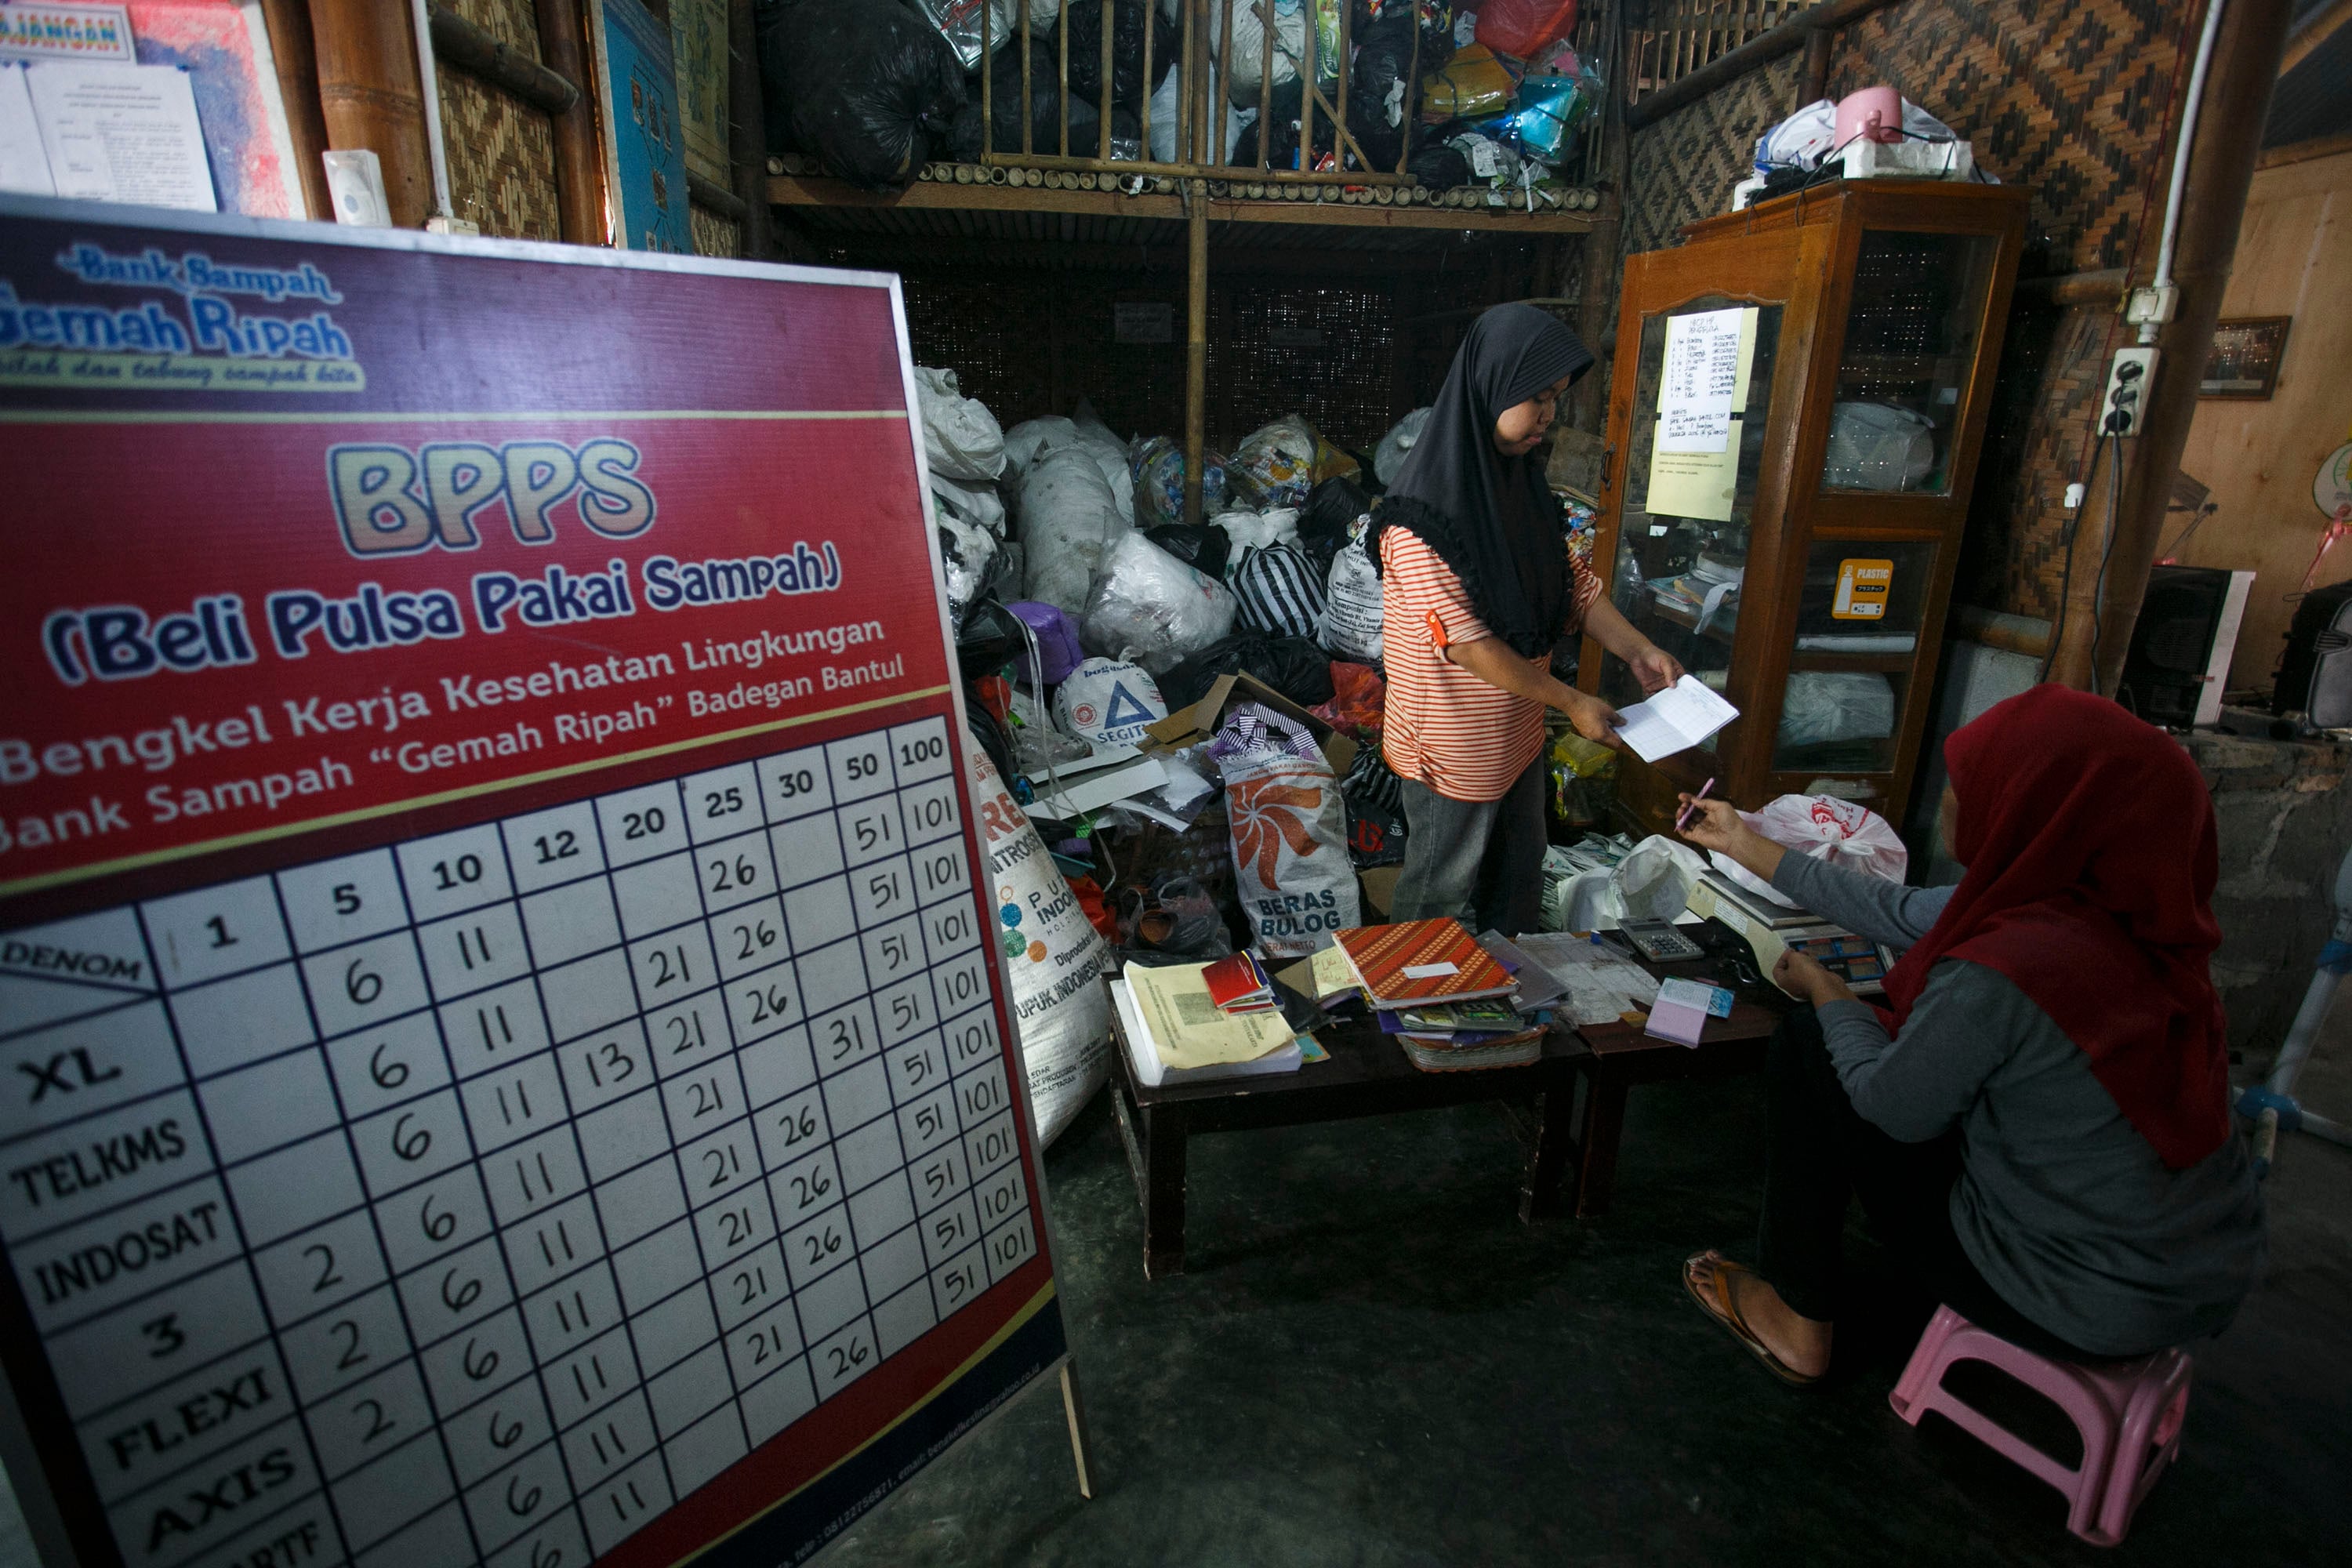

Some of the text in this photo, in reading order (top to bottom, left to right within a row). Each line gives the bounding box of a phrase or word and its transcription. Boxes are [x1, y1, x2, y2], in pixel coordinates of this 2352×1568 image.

[181, 251, 343, 304] Sampah
[188, 292, 354, 361] Ripah
[326, 439, 656, 560] BPPS
[1857, 568, 1889, 579] PLASTIC
[0, 617, 885, 784] Bengkel Kerja Kesehatan Lingkungan
[42, 593, 257, 686] (Beli
[267, 582, 465, 659] Pulsa
[474, 557, 635, 633] Pakai
[146, 756, 354, 822] Sampah
[688, 671, 813, 719] Badegan
[822, 652, 906, 692] Bantul
[2, 942, 142, 981] DENOM
[205, 915, 239, 949] 1
[332, 883, 362, 916] 5
[432, 854, 483, 891] 10
[534, 829, 580, 865] 12
[622, 808, 666, 840] 20
[705, 787, 743, 818] 25
[779, 770, 814, 798] 30
[847, 753, 878, 781] 50
[901, 737, 942, 767] 100
[18, 797, 952, 1105] XL 6 11 26 51 101
[1258, 888, 1336, 916] BERAS
[1261, 911, 1341, 936] BULOG
[10, 854, 960, 1207] TELKMS 6 11 21 26 51 101
[1014, 988, 1058, 1018] UPUK
[33, 909, 969, 1305] INDOSAT 6 11 13 21 26 51 101
[142, 967, 979, 1359] 3 2 6 11 21 31 51 101
[107, 1020, 992, 1472] FLEXI 2 6 11 21 26 51 101
[147, 1076, 998, 1554] AXIS 2 6 11 21 26 51 101
[488, 1411, 523, 1450] 6
[572, 1355, 607, 1403] 11
[733, 1267, 767, 1305] 21
[804, 1226, 841, 1265] 26
[925, 1159, 954, 1198] 51
[976, 1128, 1008, 1166] 101
[506, 1179, 1017, 1517] 6 11 21 51 101
[610, 1481, 645, 1522] 11
[828, 1337, 868, 1379] 26
[944, 1265, 974, 1303] 51
[995, 1227, 1026, 1265] 101
